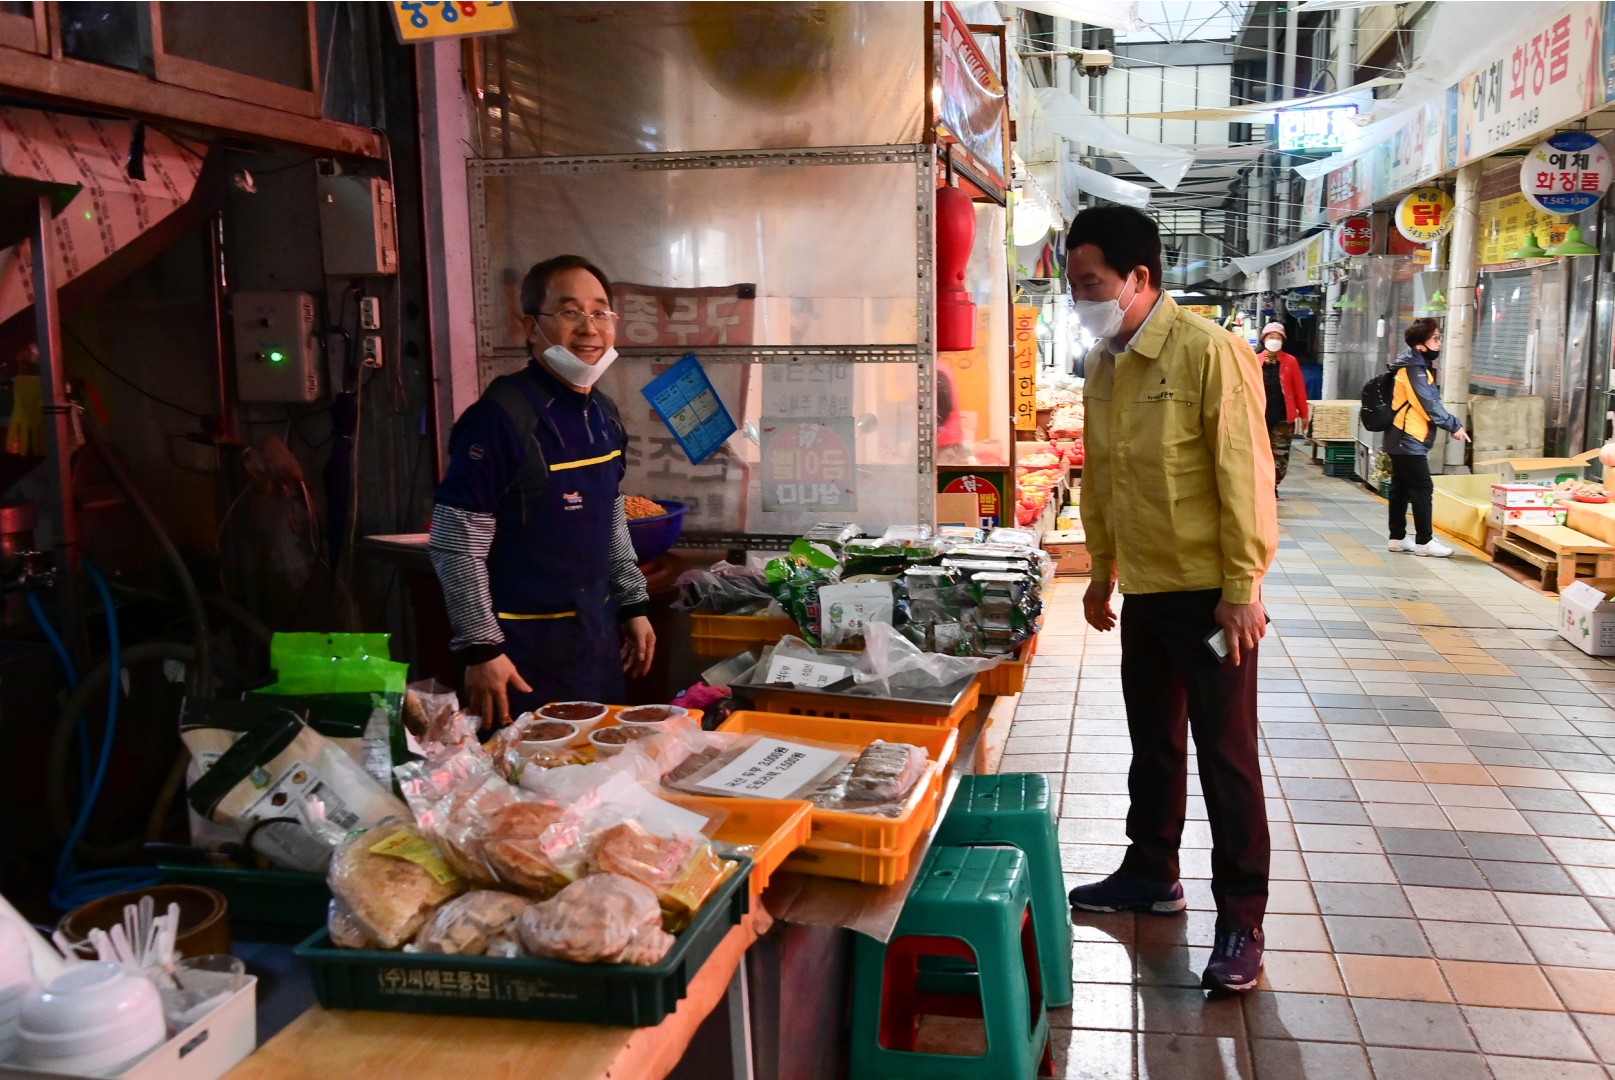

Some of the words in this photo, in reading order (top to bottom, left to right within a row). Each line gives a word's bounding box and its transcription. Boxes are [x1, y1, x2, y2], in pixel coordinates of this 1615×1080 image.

[1510, 14, 1571, 100] 화장품
[1549, 153, 1589, 170] 에체
[1536, 171, 1599, 191] 화장품
[1413, 204, 1443, 226] 닭
[1344, 227, 1371, 238] 속옷
